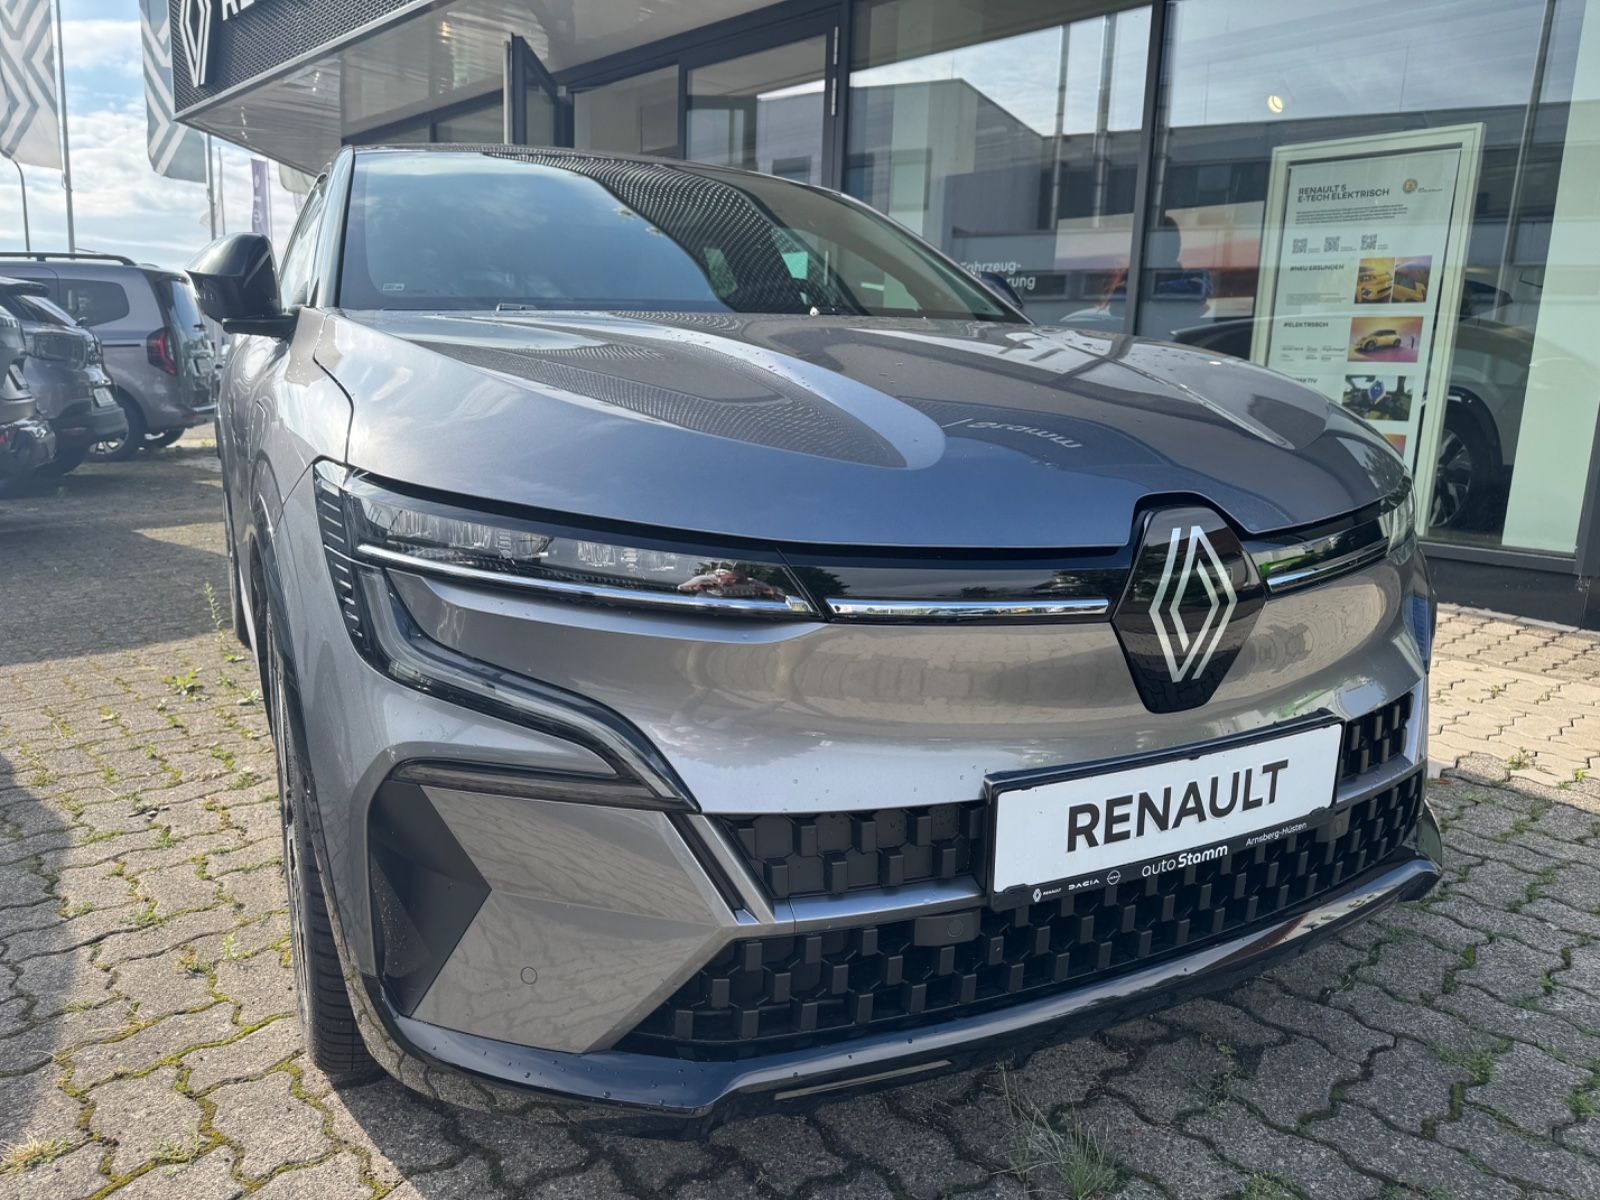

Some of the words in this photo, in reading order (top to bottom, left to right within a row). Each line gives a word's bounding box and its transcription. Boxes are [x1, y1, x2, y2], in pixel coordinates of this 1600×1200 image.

[1297, 193, 1330, 203] E-TECH
[1331, 188, 1390, 201] ELEKTRISCH
[1298, 185, 1341, 195] RENAULT
[1066, 759, 1289, 853] RENAULT
[1068, 879, 1100, 890] DACIA
[1141, 857, 1176, 877] auto
[1178, 845, 1228, 868] Stamm
[1245, 822, 1307, 847] Arnsberg-Hüsten
